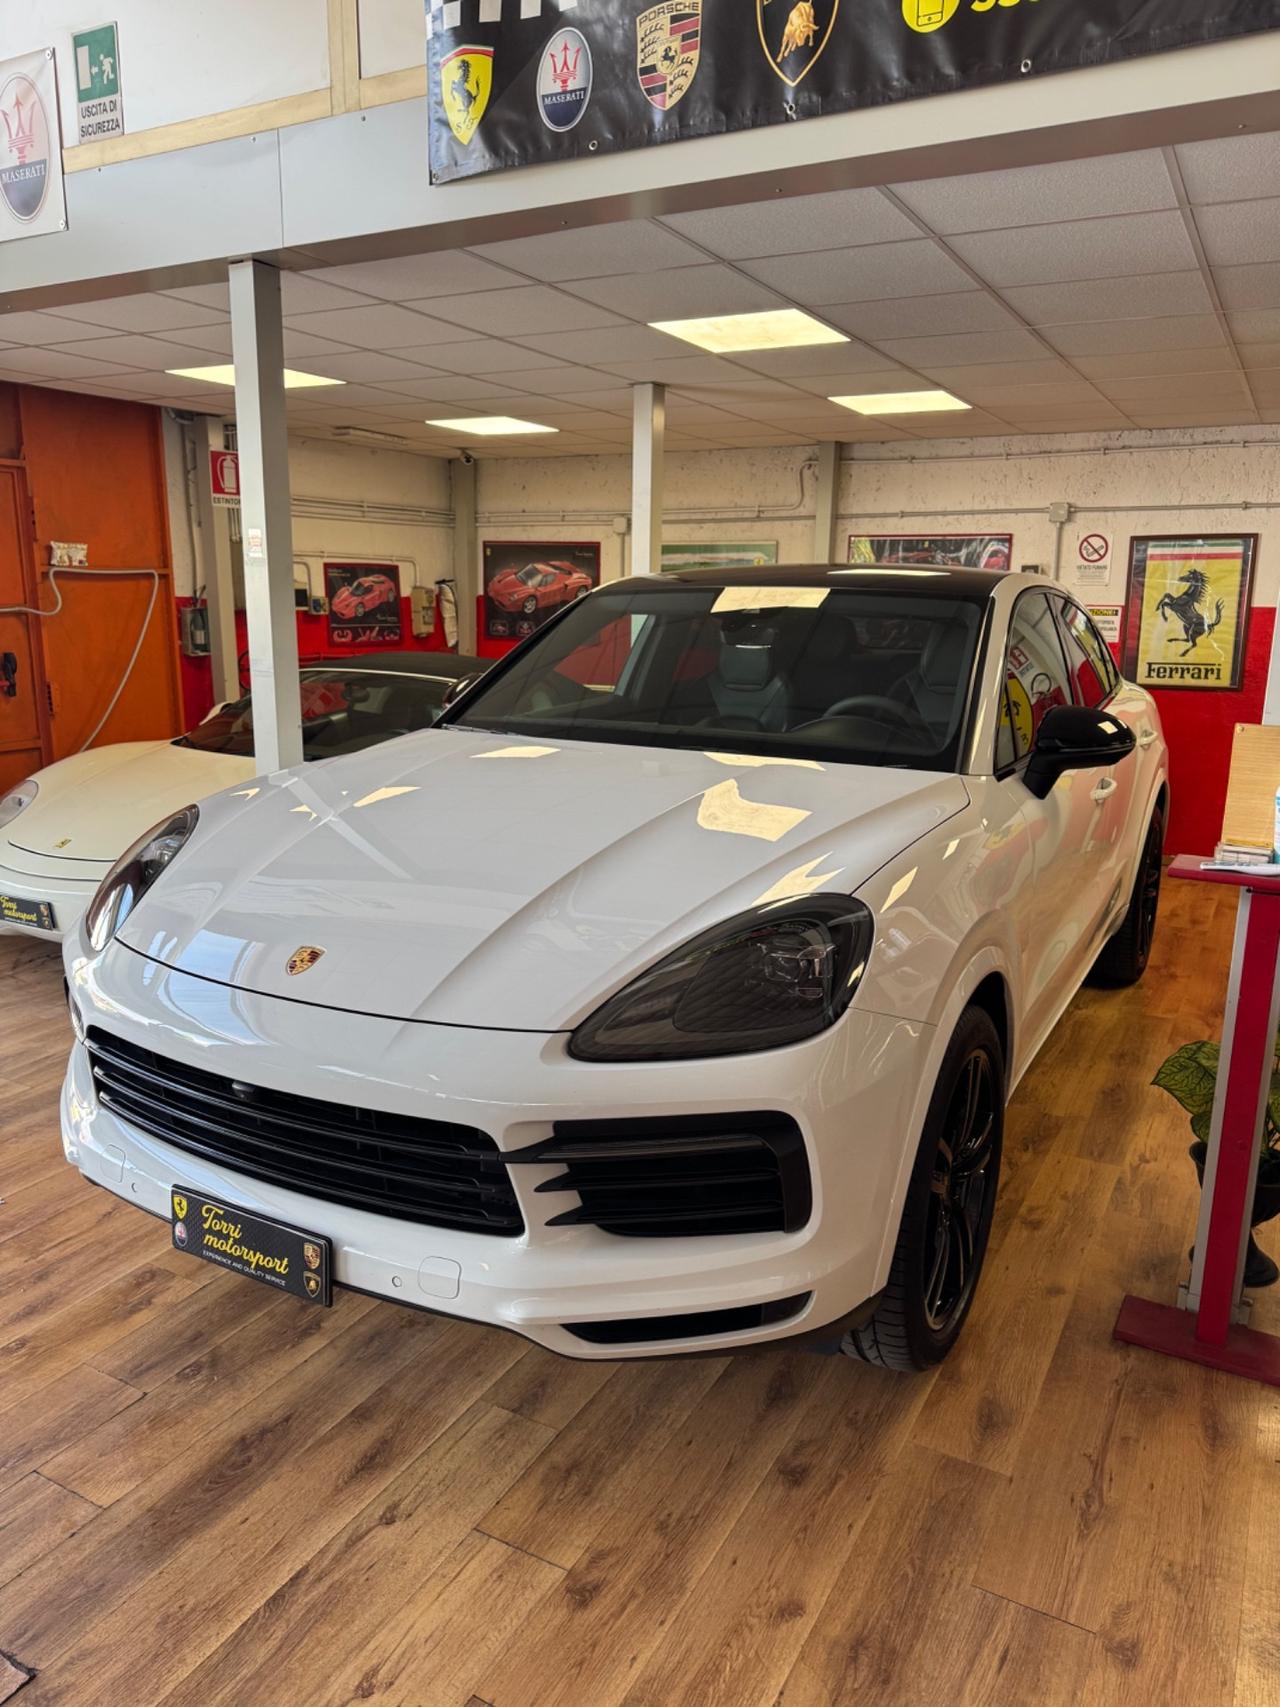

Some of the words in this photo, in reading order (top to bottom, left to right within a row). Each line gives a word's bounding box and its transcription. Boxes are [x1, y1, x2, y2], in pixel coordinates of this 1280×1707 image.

[639, 2, 700, 28] PORSCHE
[544, 90, 585, 105] MASERATI
[81, 101, 108, 119] USCITA
[109, 99, 117, 113] DI
[80, 117, 120, 137] SICUREZZA
[1, 163, 45, 184] MASERATI
[1145, 662, 1222, 680] Ferrari
[202, 1204, 242, 1239] Torri
[203, 1234, 289, 1275] motorsport
[202, 1250, 231, 1265] EXPERIENCE
[232, 1261, 243, 1270] AND
[243, 1265, 265, 1278] QUALITY
[265, 1273, 286, 1287] SERVICE
